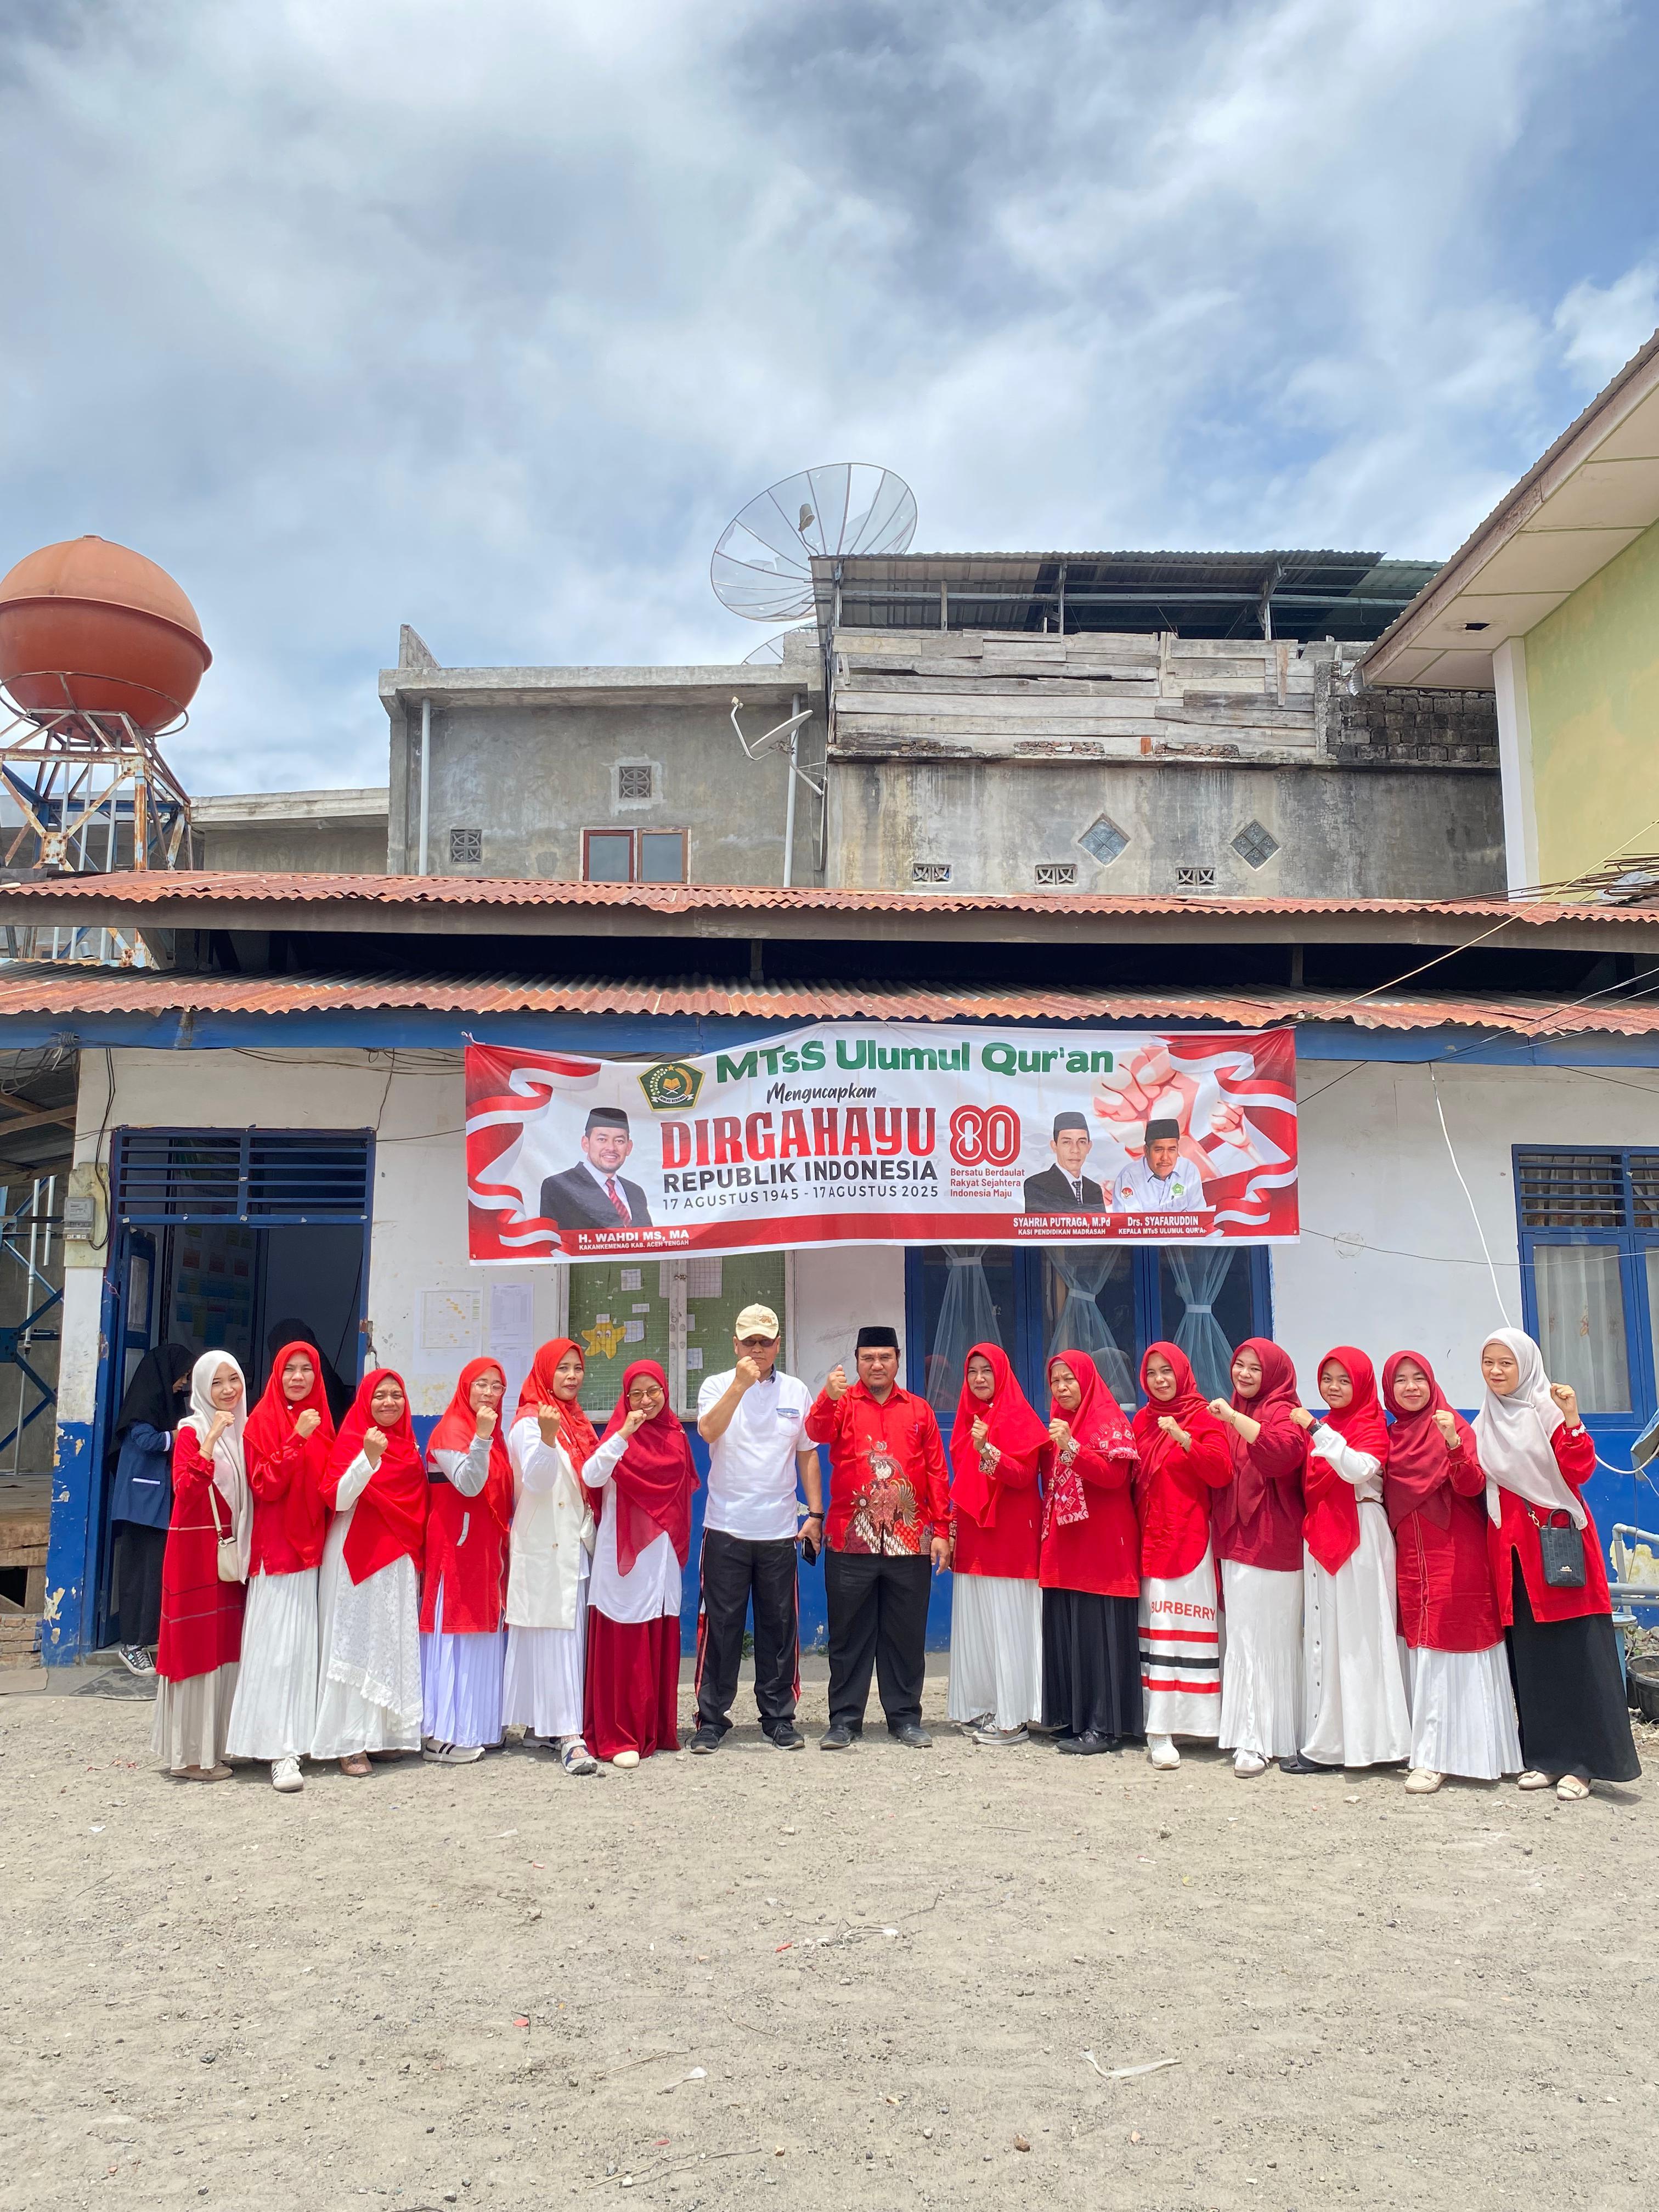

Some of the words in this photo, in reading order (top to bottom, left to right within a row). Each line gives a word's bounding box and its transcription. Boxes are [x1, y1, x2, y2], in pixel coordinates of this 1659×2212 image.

[716, 1040, 827, 1084] MTsS
[836, 1040, 970, 1071] Ulumul
[981, 1042, 1114, 1076] Qur'an
[766, 1081, 877, 1104] Mengucapkan
[660, 1107, 936, 1170] DIRGAHAYU
[949, 1104, 1020, 1167] 80
[663, 1162, 798, 1194] REPUBLIK
[804, 1160, 938, 1181] INDONESIA
[950, 1168, 983, 1176] Bersatu
[985, 1168, 1025, 1176] Berdaulat
[950, 1178, 980, 1188] Rakyat
[981, 1178, 1021, 1188] Sejahtera
[663, 1198, 679, 1210] 17
[684, 1191, 759, 1209] AGUSTUS
[763, 1188, 799, 1202] 1945
[901, 1185, 939, 1198] 2025
[950, 1189, 991, 1197] Indonesia
[993, 1189, 1012, 1199] Maju
[1013, 1217, 1048, 1227] SYAHRIA
[1049, 1217, 1090, 1229] PUTRAGA,
[1092, 1216, 1111, 1227] M.Pd
[1127, 1216, 1143, 1227] Drs.
[1144, 1215, 1199, 1227] SYAFARUDDIN
[578, 1234, 592, 1243] H.
[595, 1232, 639, 1243] WAHDI
[643, 1231, 665, 1242] MS,
[669, 1229, 690, 1239] MA
[579, 1242, 630, 1250] KAKANKEMENAG
[1150, 1600, 1216, 1621] BURBERRY
